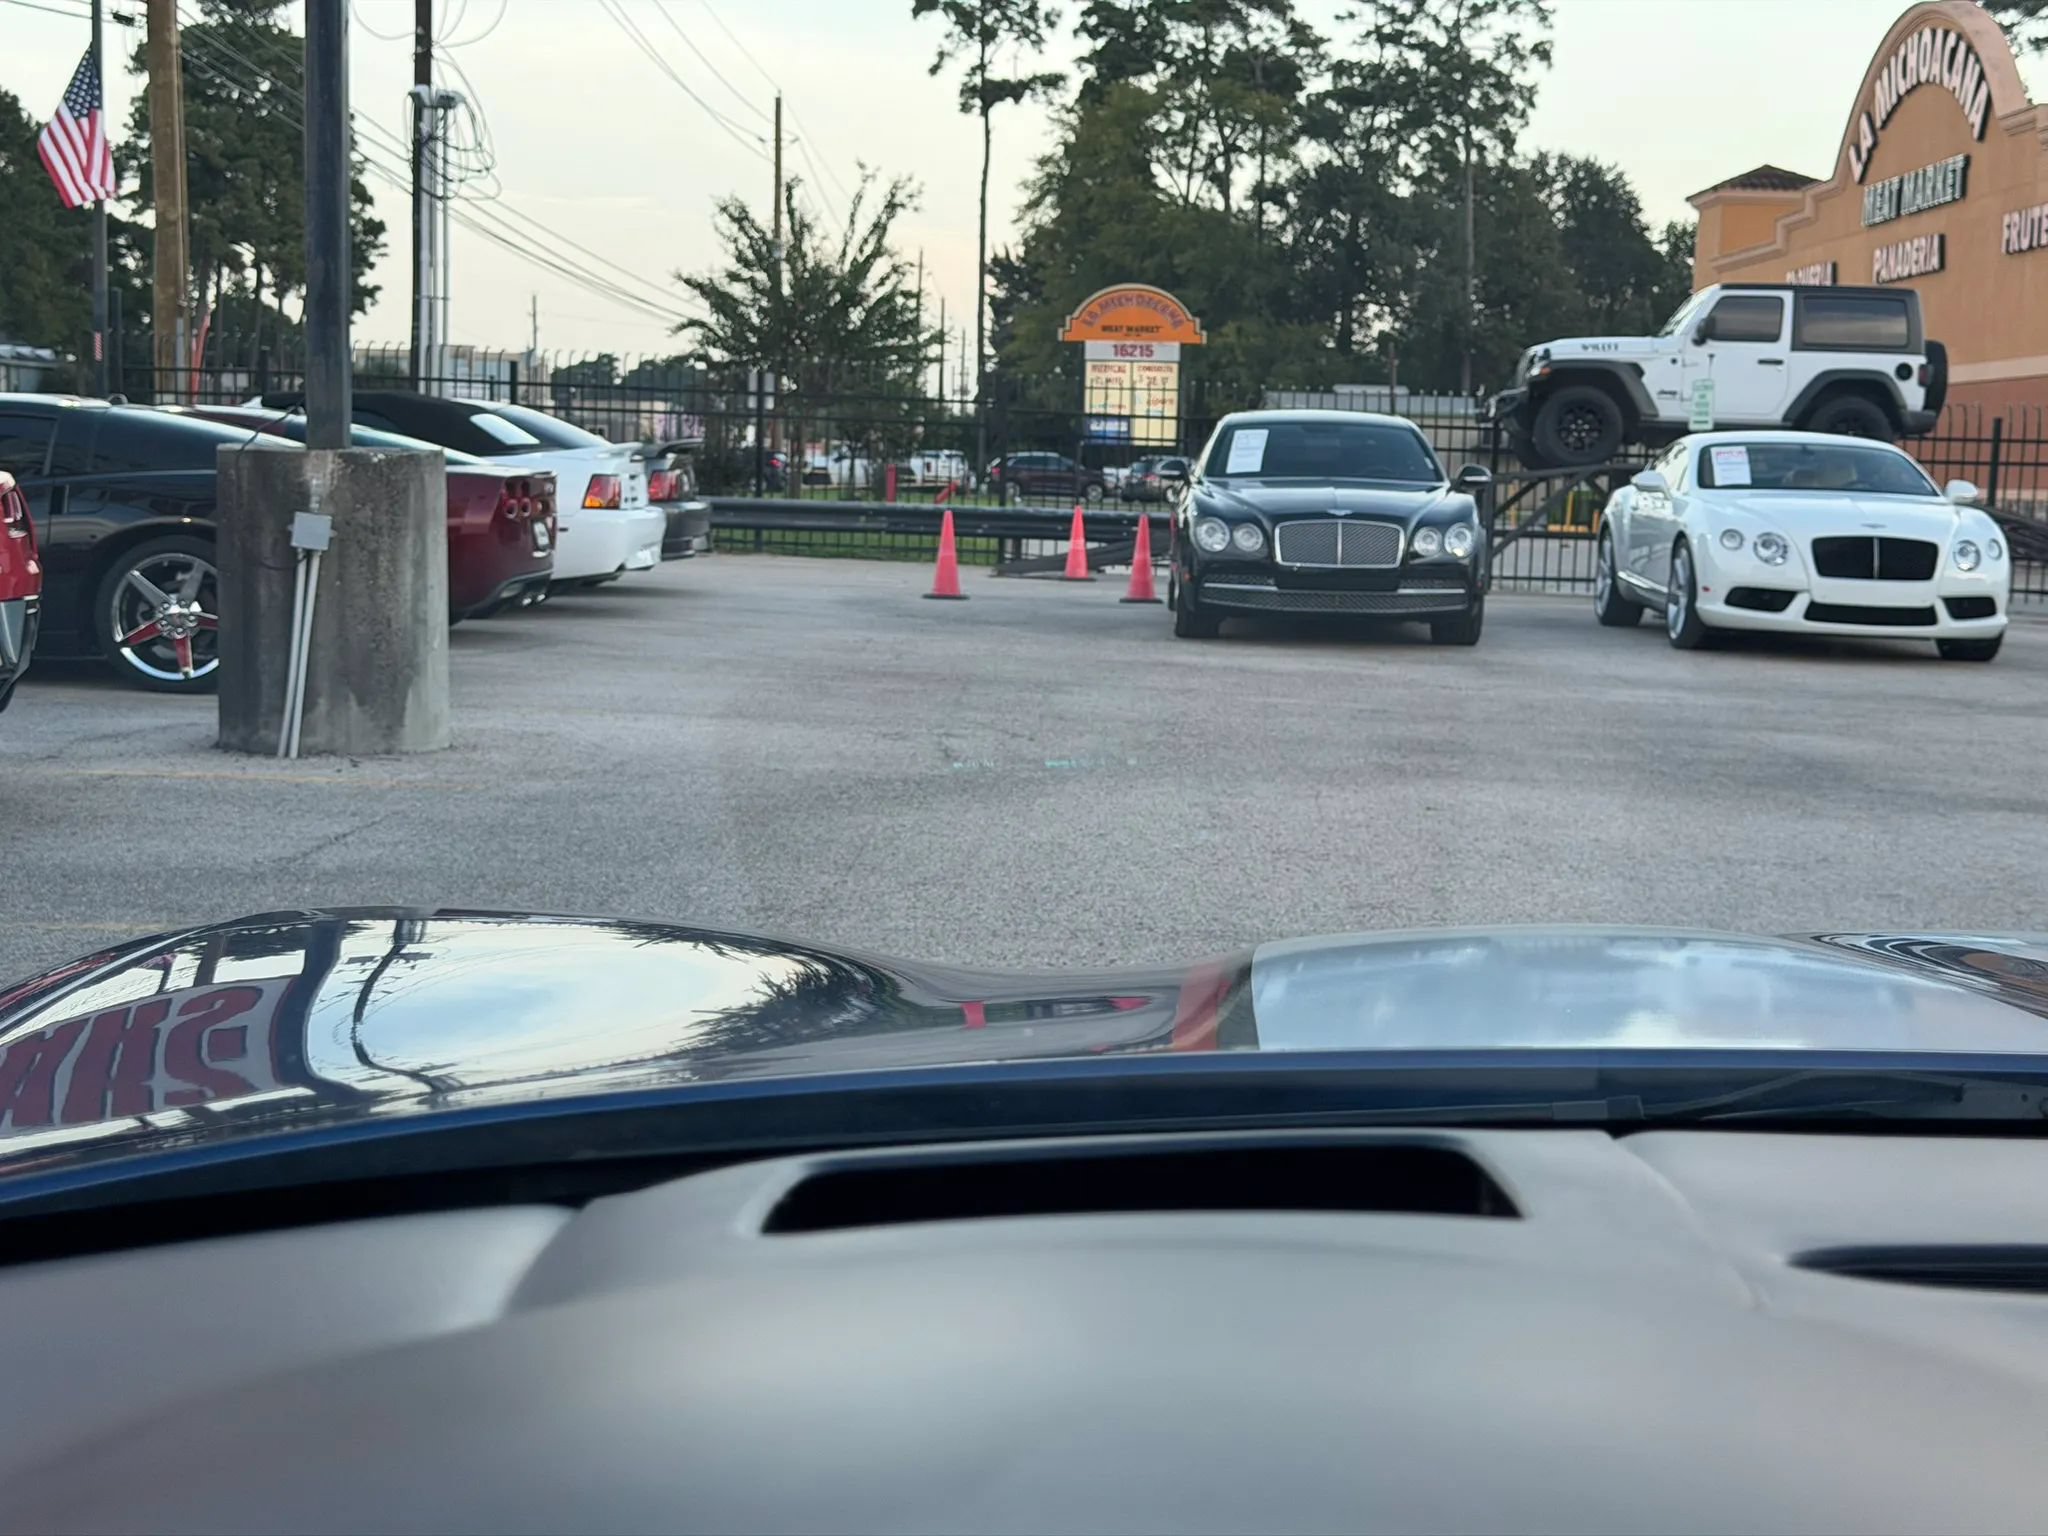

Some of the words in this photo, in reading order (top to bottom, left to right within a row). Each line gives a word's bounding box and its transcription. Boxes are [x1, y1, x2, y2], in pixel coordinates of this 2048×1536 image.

[1849, 111, 1875, 184] LA
[1873, 26, 1990, 141] MICHOACANA
[1861, 175, 1900, 227] MEAT
[1900, 153, 1967, 216] MARKET
[1872, 233, 1941, 284] PANADERIA
[1111, 343, 1155, 358] 16215
[1126, 324, 1161, 333] MARKET
